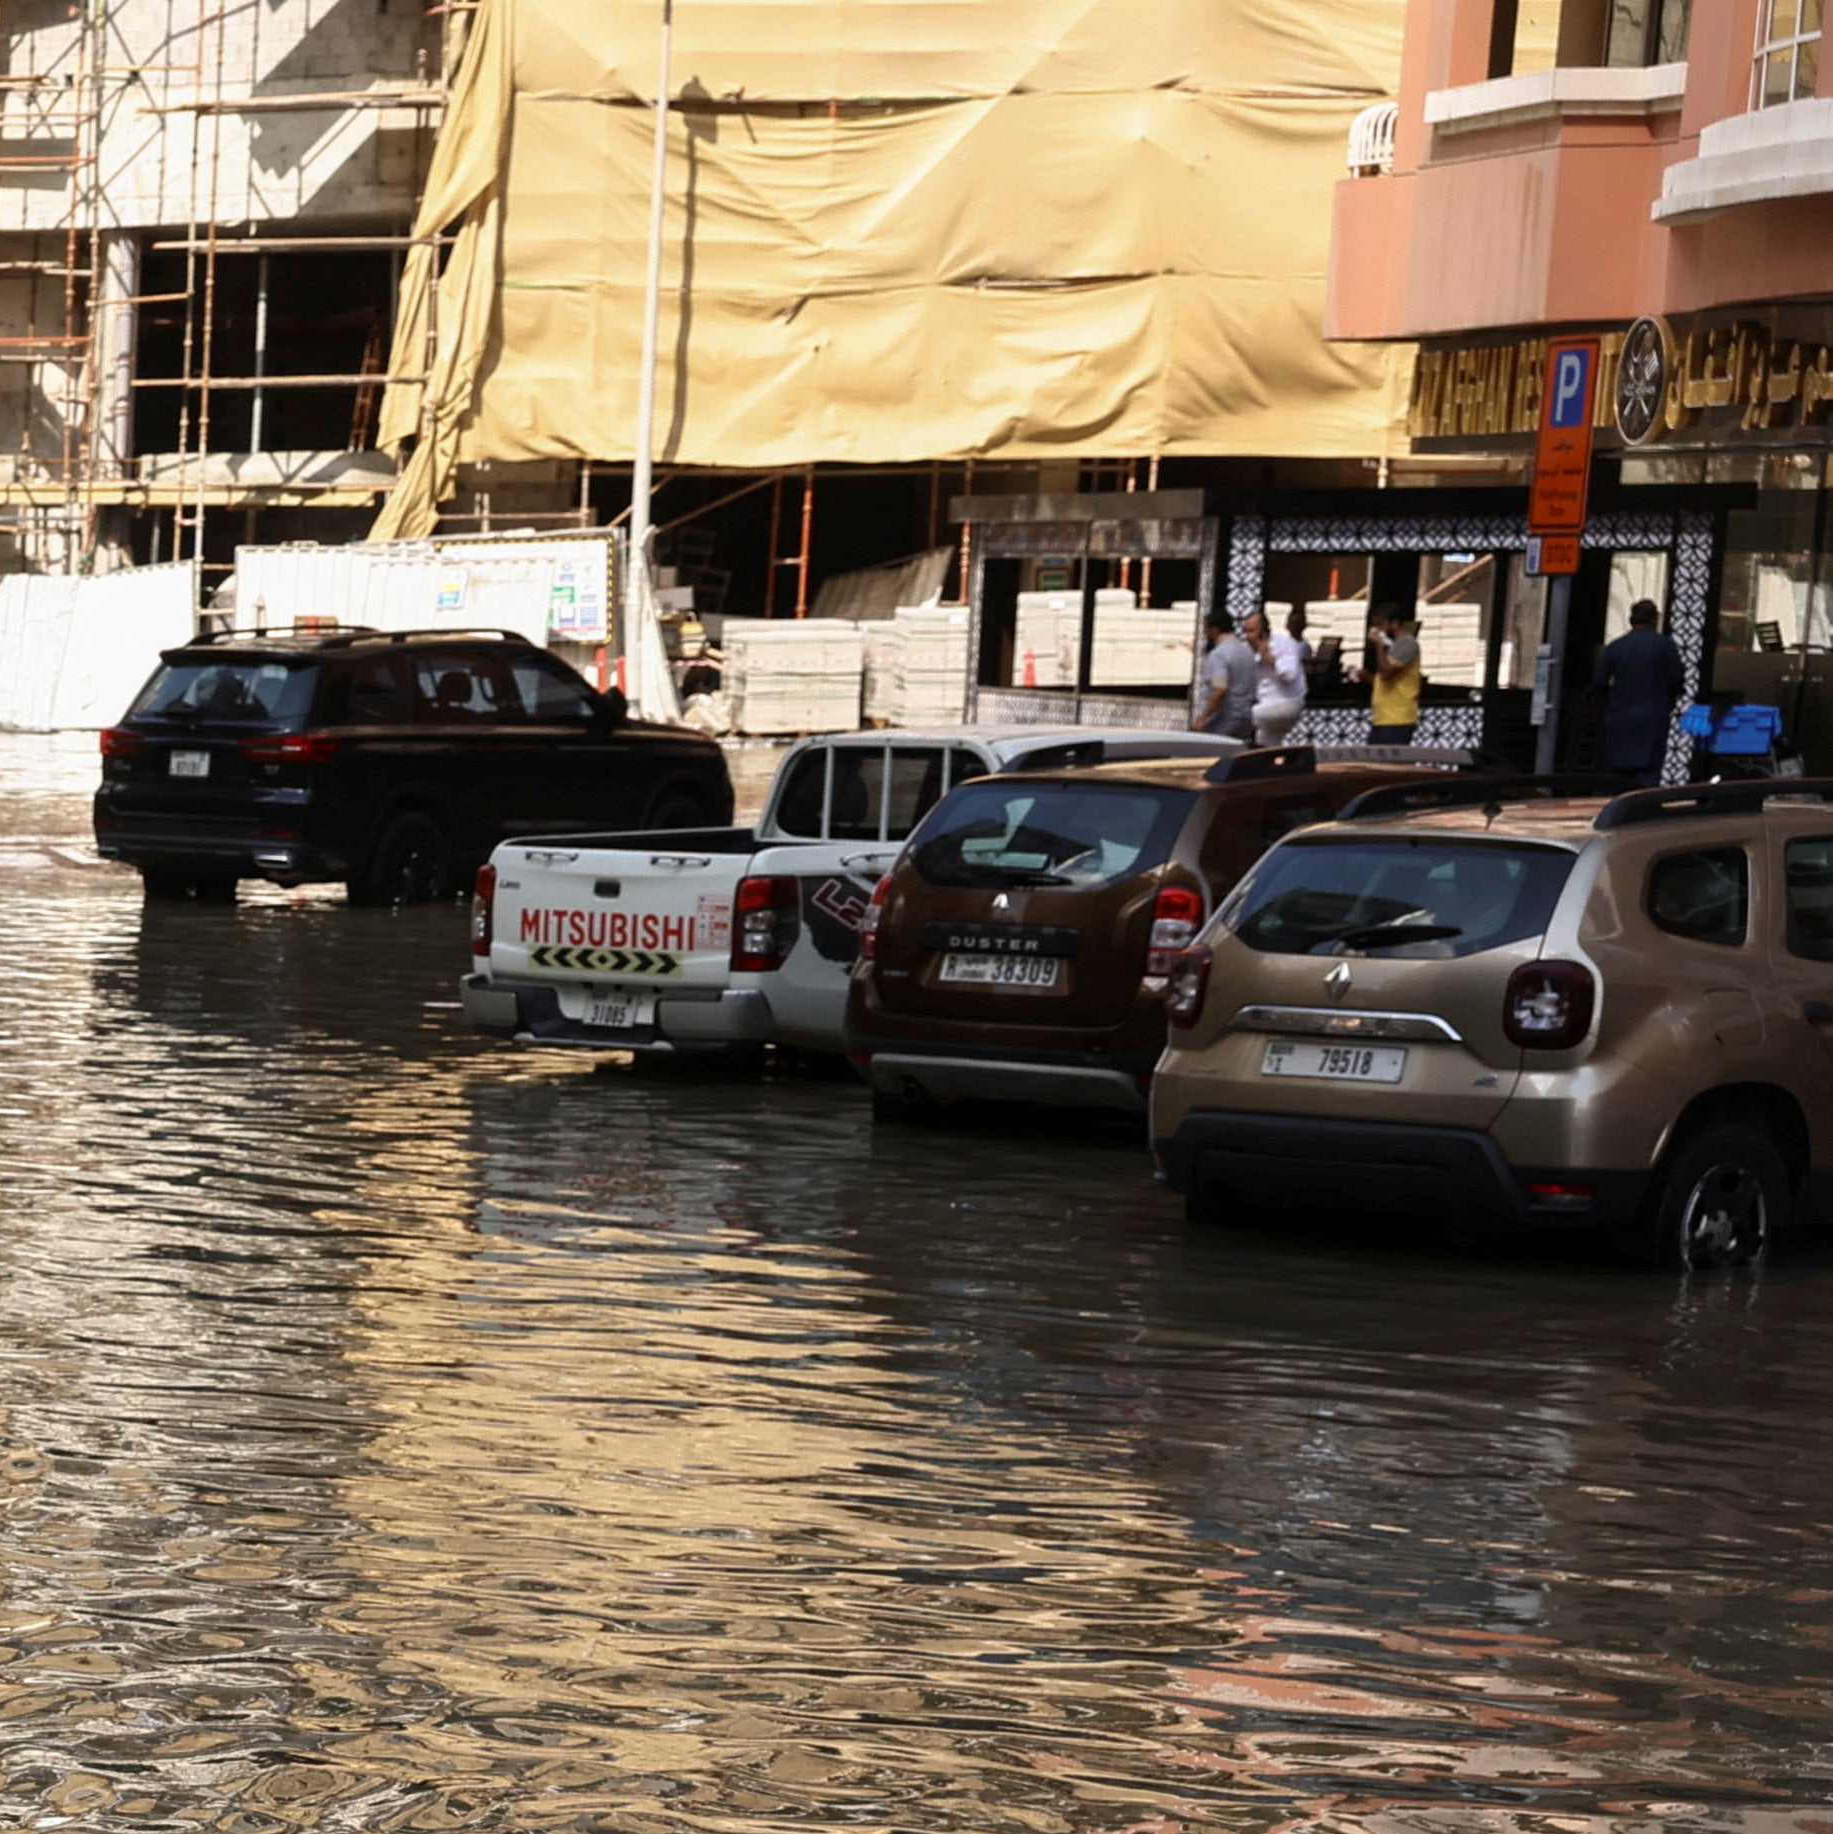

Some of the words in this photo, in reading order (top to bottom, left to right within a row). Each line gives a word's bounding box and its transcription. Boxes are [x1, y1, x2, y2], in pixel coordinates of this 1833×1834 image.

[1556, 354, 1582, 422] P
[520, 907, 696, 951] MITSUBISHI
[949, 935, 1039, 951] DUSTER
[991, 953, 1055, 986] 38309
[1318, 1047, 1374, 1075] 79518
